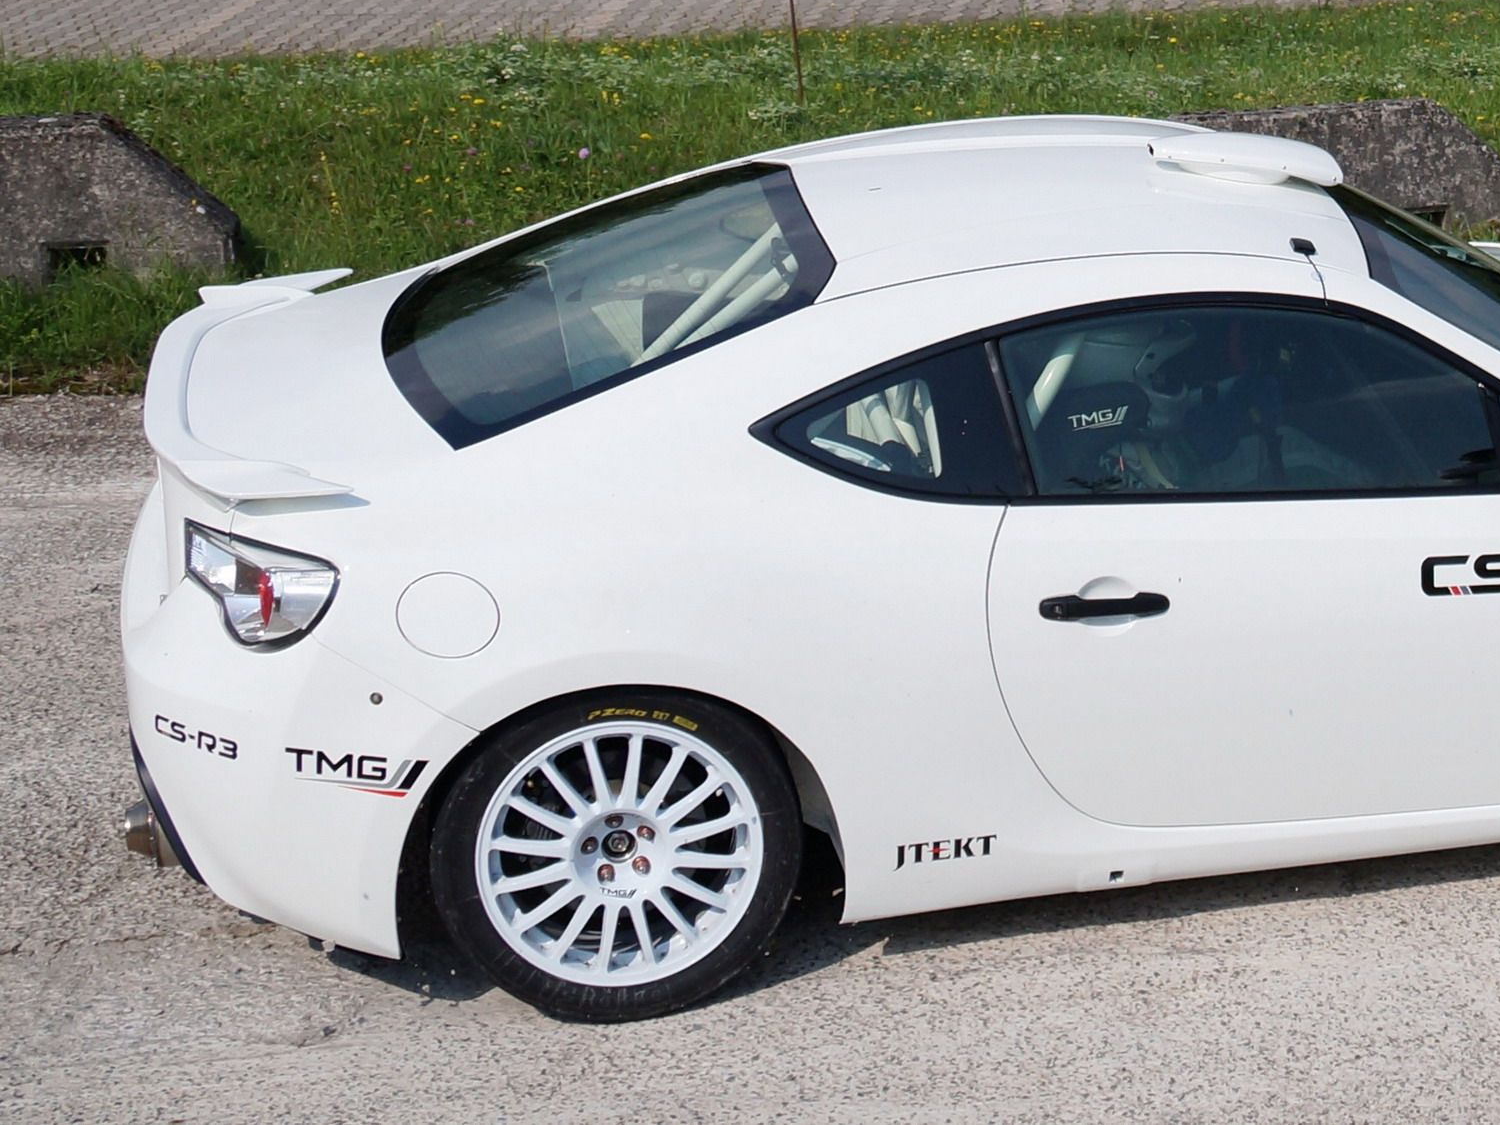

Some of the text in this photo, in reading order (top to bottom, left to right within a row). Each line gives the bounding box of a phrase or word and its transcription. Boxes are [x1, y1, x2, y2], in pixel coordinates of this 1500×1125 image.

[1067, 408, 1113, 428] TMG
[155, 714, 238, 760] CS-R3
[285, 747, 387, 781] TMG
[894, 834, 997, 871] JTEKT
